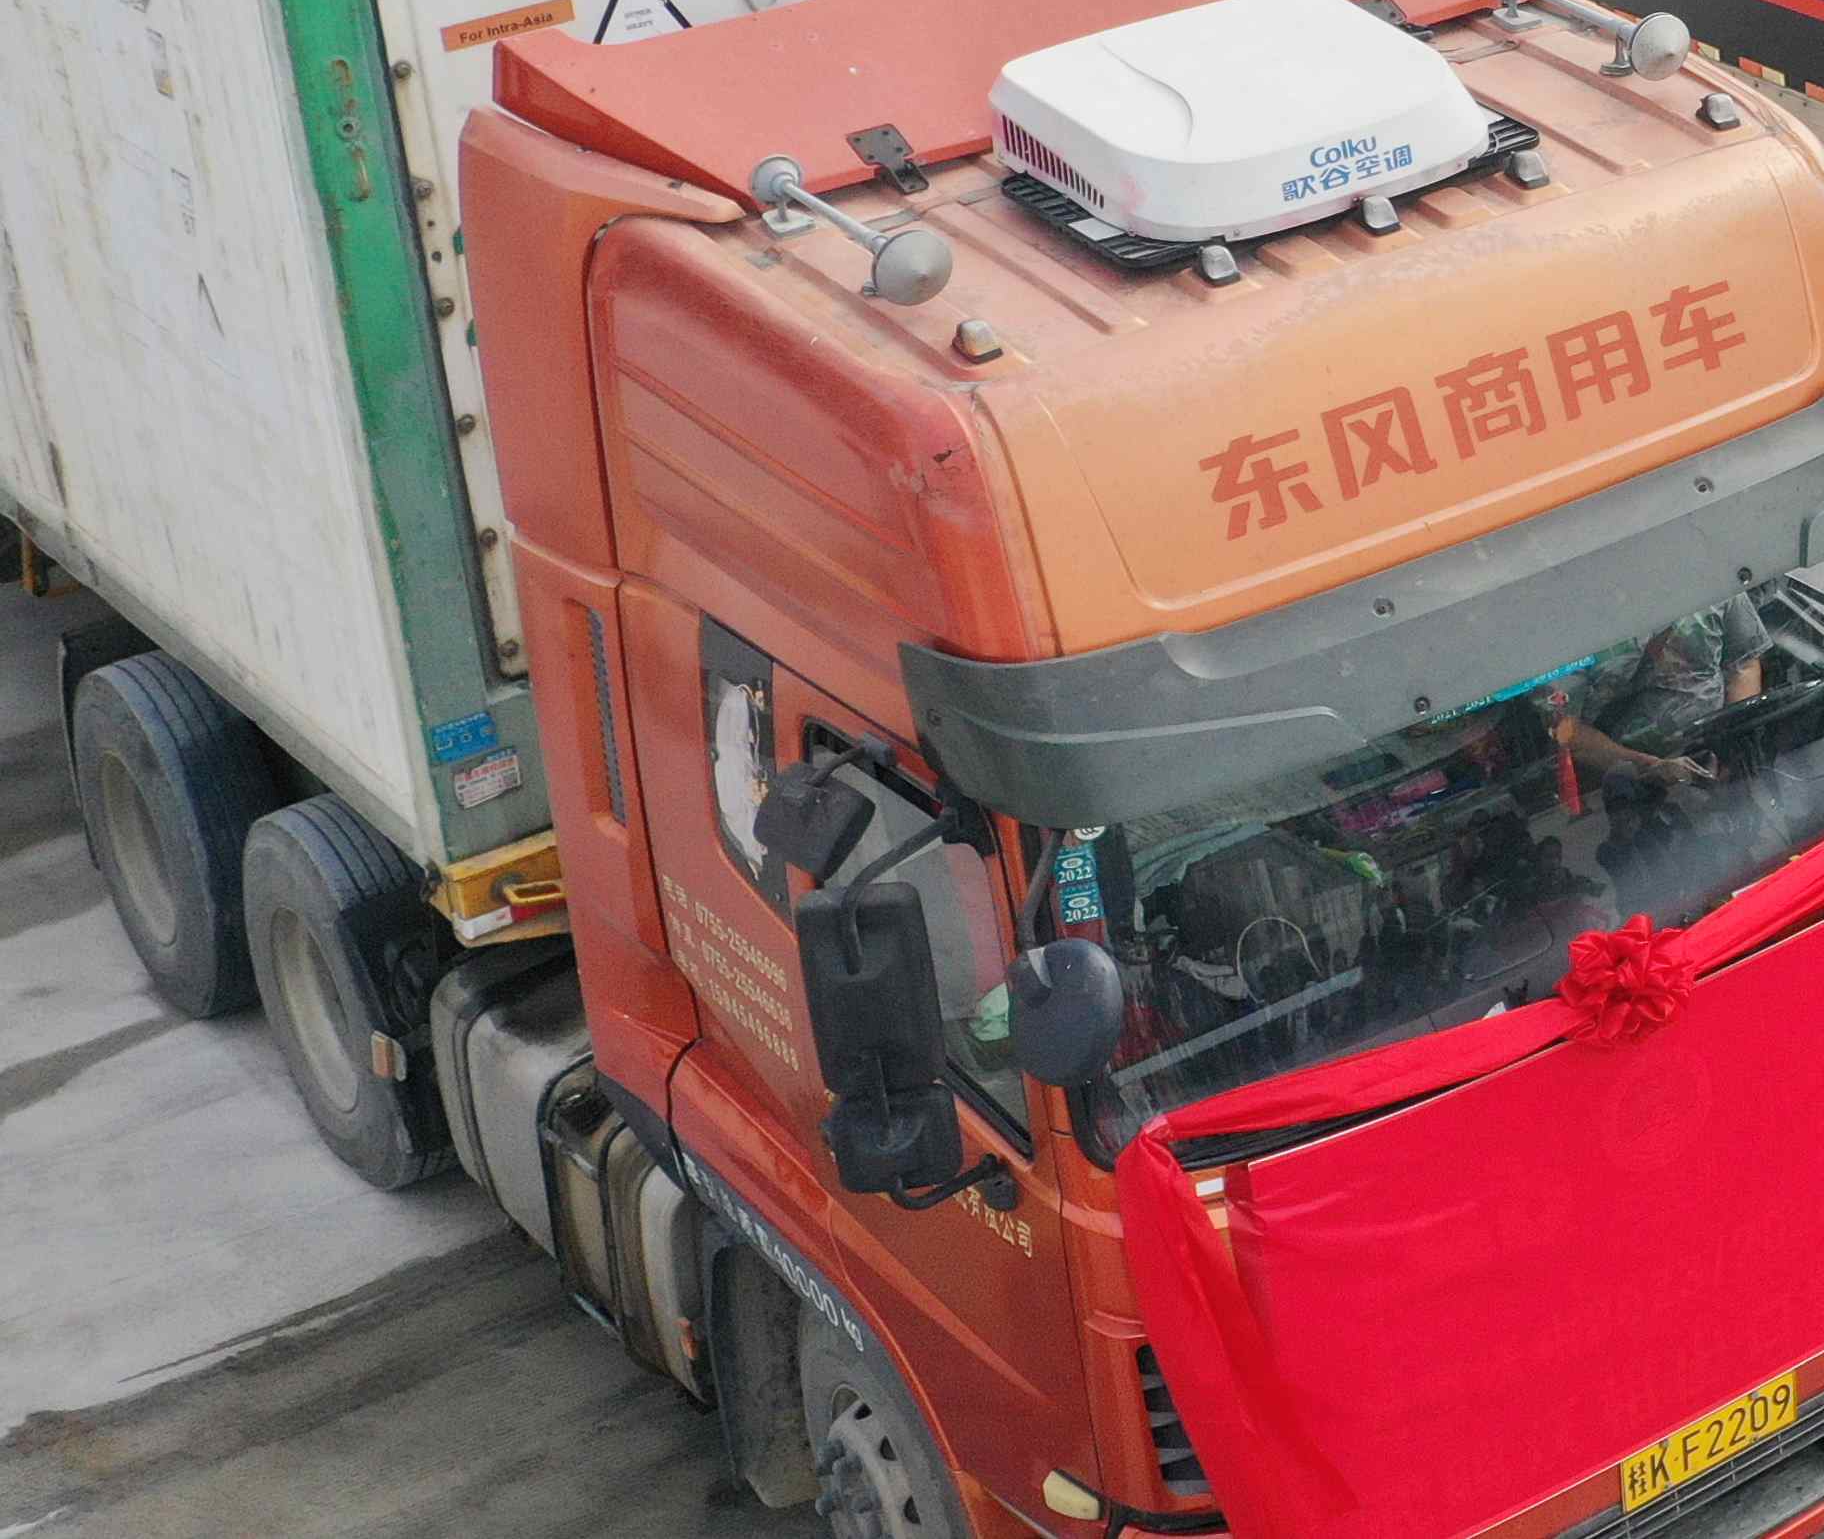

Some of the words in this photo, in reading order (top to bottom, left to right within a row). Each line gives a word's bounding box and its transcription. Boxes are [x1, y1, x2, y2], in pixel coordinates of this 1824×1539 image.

[459, 30, 484, 44] For
[487, 12, 554, 38] Intra-Asia
[1309, 135, 1378, 171] Colku
[1282, 145, 1414, 203] 歌谷空调
[1200, 278, 1747, 541] 东风商用车
[1058, 865, 1095, 884] 2022
[1065, 905, 1100, 924] 2022
